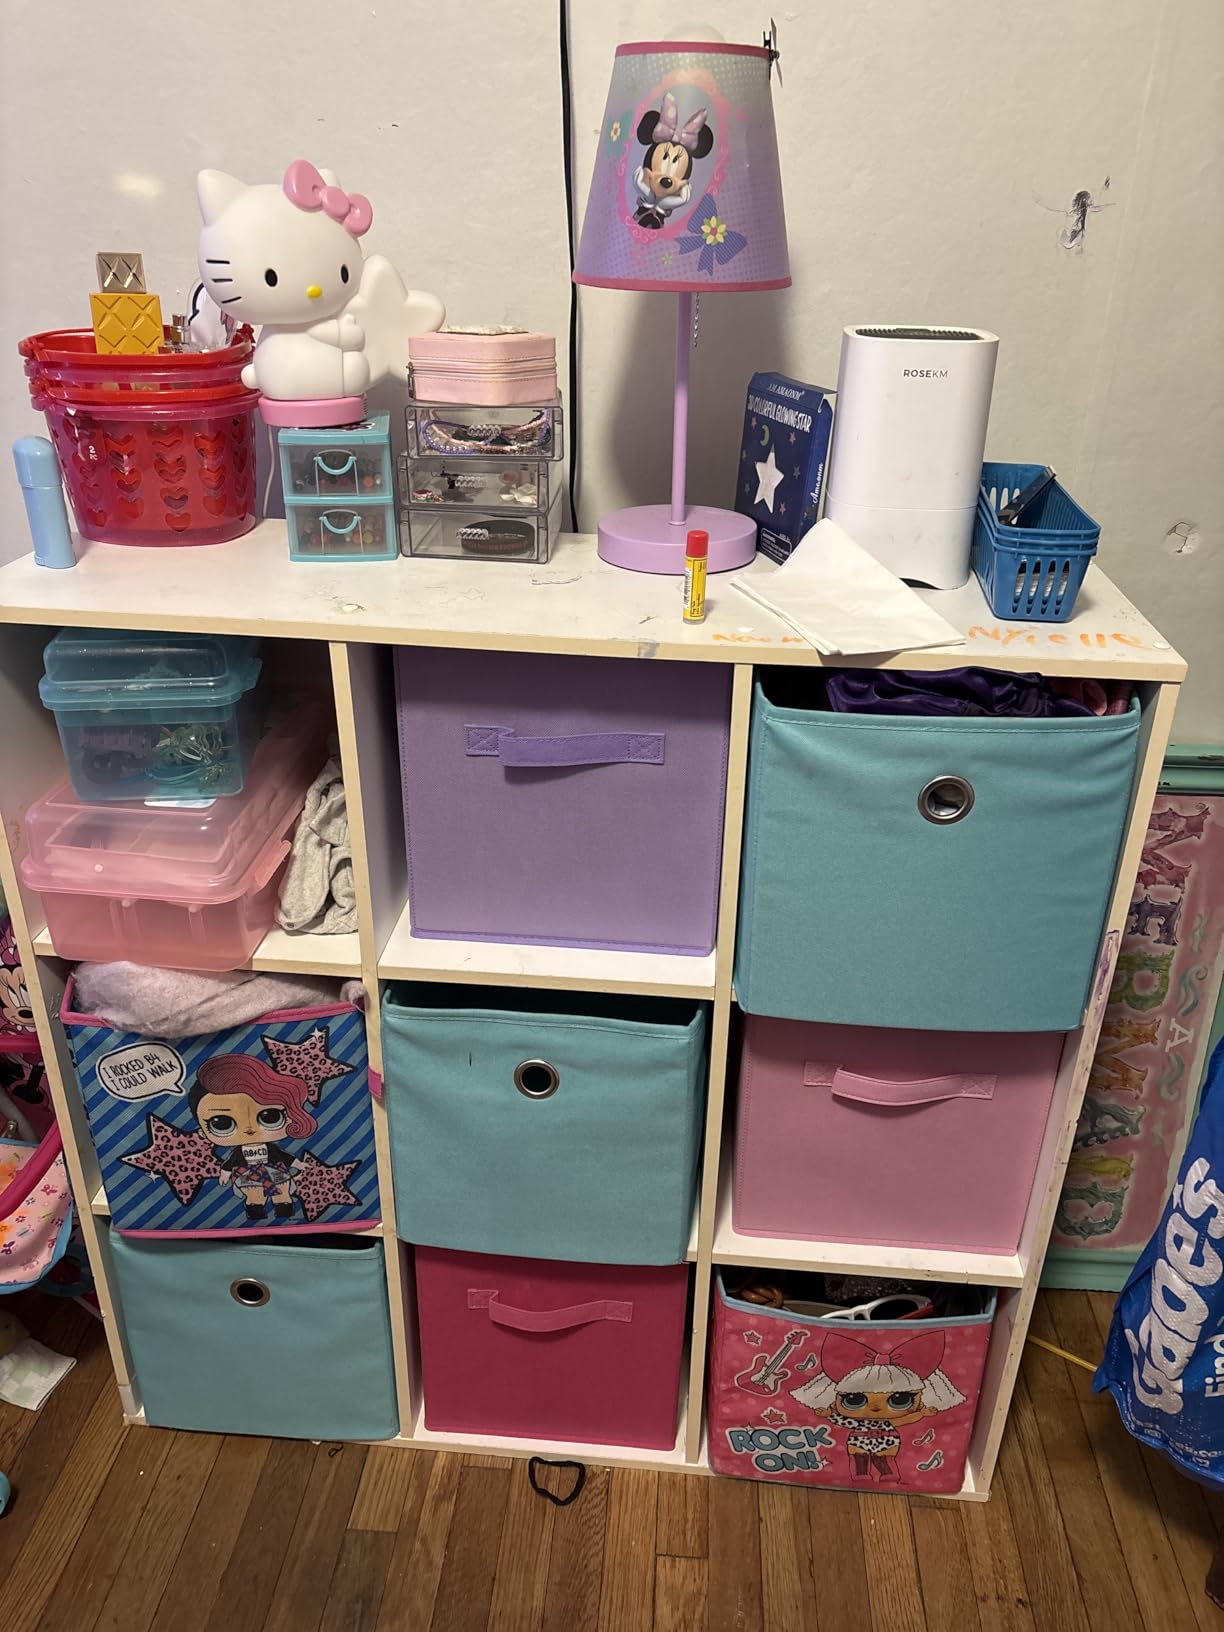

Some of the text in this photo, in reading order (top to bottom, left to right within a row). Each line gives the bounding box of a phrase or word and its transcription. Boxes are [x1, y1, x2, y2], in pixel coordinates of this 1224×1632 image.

[903, 369, 948, 378] ROSEKM
[796, 412, 812, 433] STAR
[1054, 802, 1211, 1241] MERMAID
[1165, 1017, 1194, 1054] A
[102, 1053, 162, 1079] I ROCKED B4
[110, 1060, 179, 1091] I COULD WALK
[728, 1426, 833, 1453] ROCK
[754, 1450, 821, 1473] ON!
